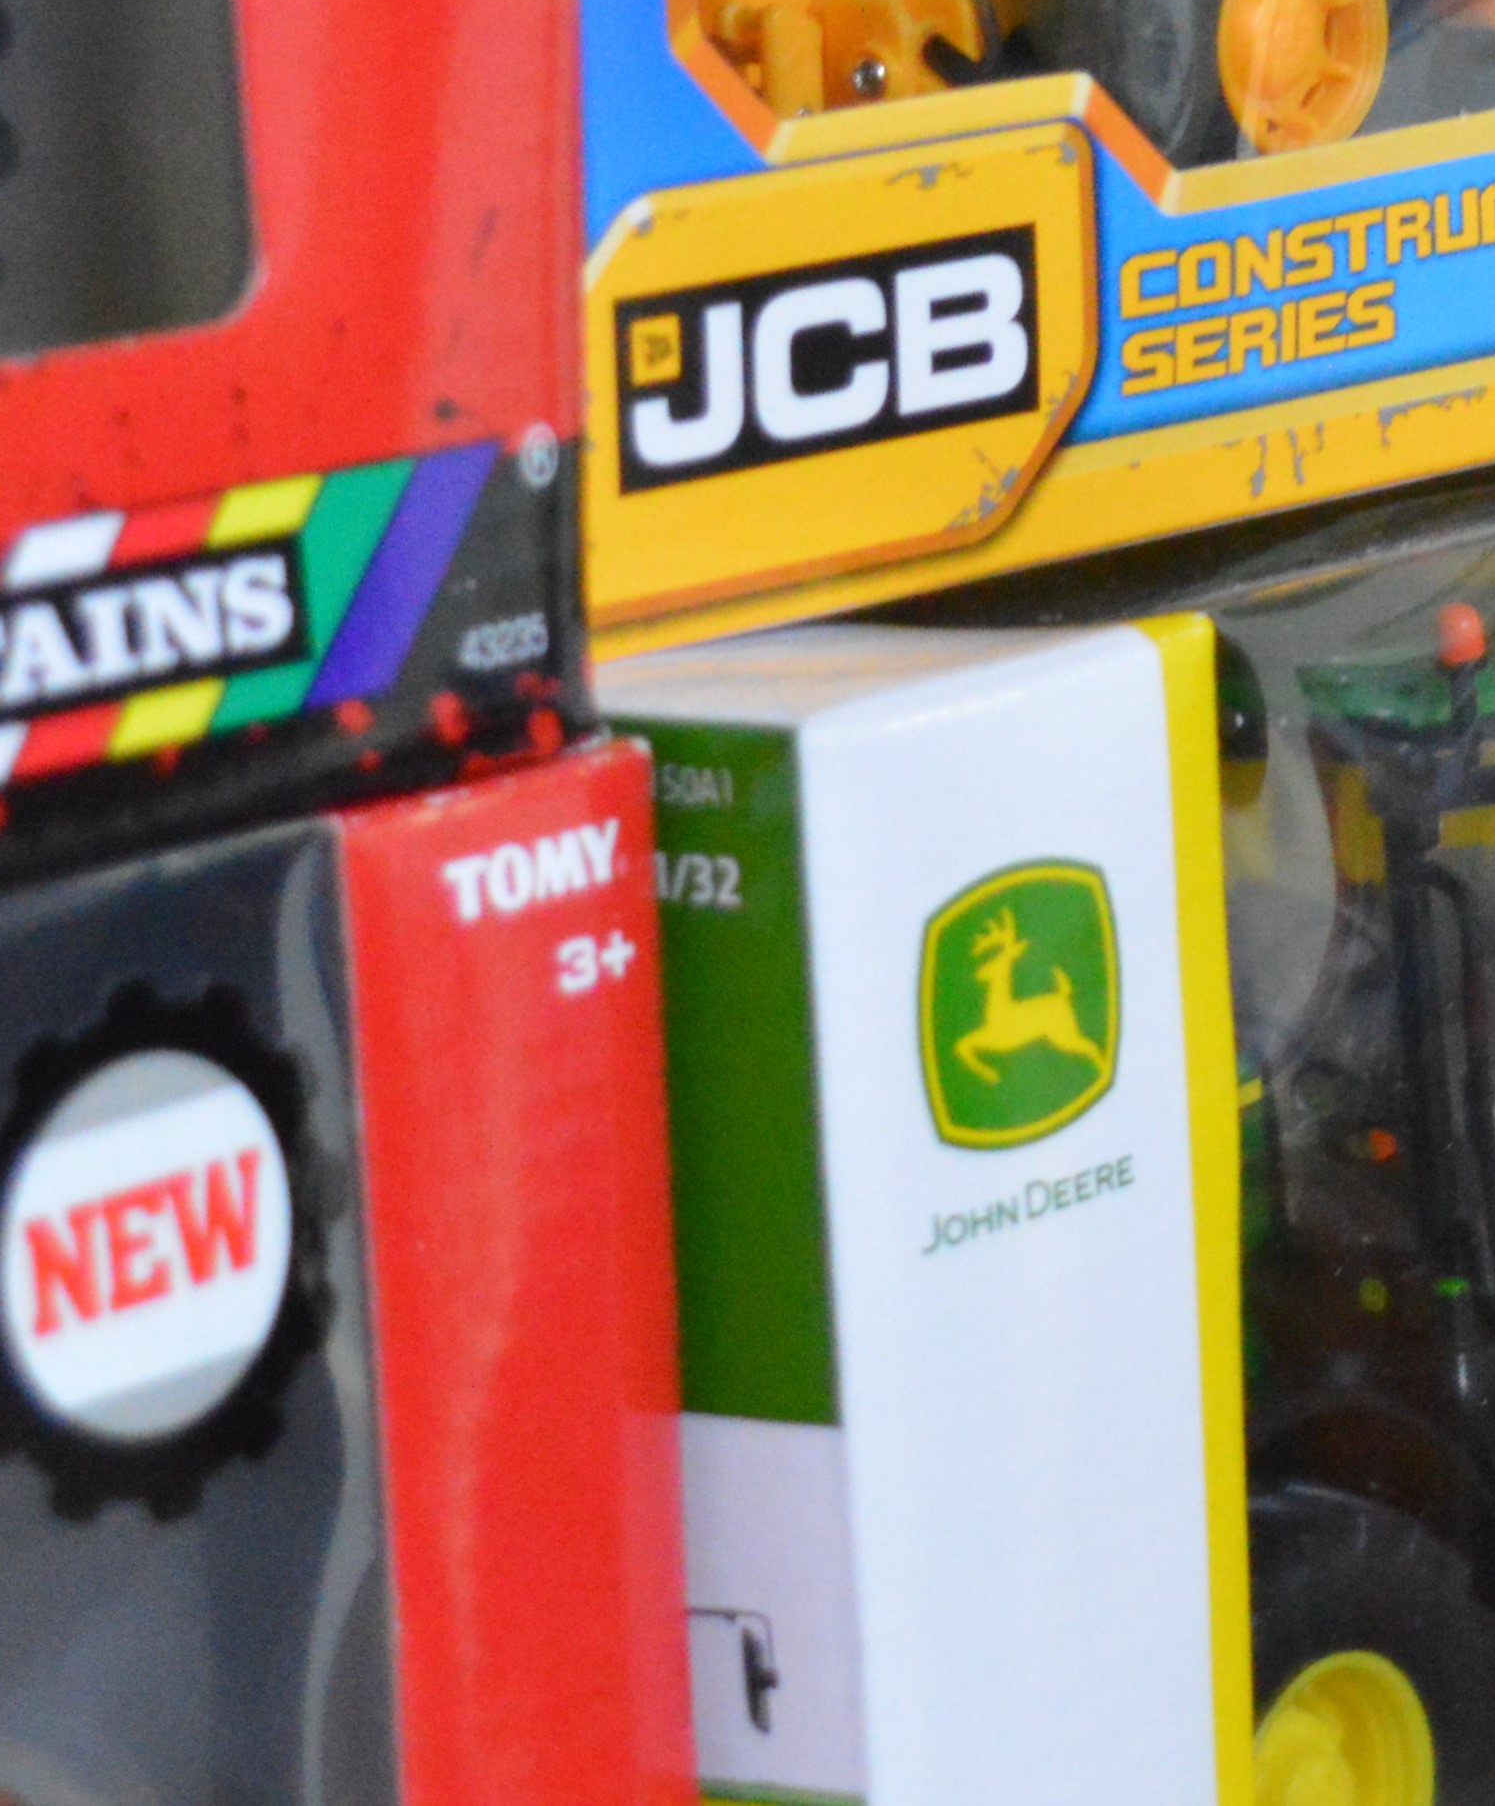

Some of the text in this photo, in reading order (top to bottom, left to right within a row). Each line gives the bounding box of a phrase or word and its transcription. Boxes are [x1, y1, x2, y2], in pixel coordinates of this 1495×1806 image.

[631, 252, 1031, 470] JCB
[1119, 281, 1398, 399] SERIES
[441, 817, 623, 923] TOMY
[556, 930, 636, 995] 3+
[24, 1148, 263, 1339] NEW
[920, 1154, 1136, 1256] JOHN DEERE
